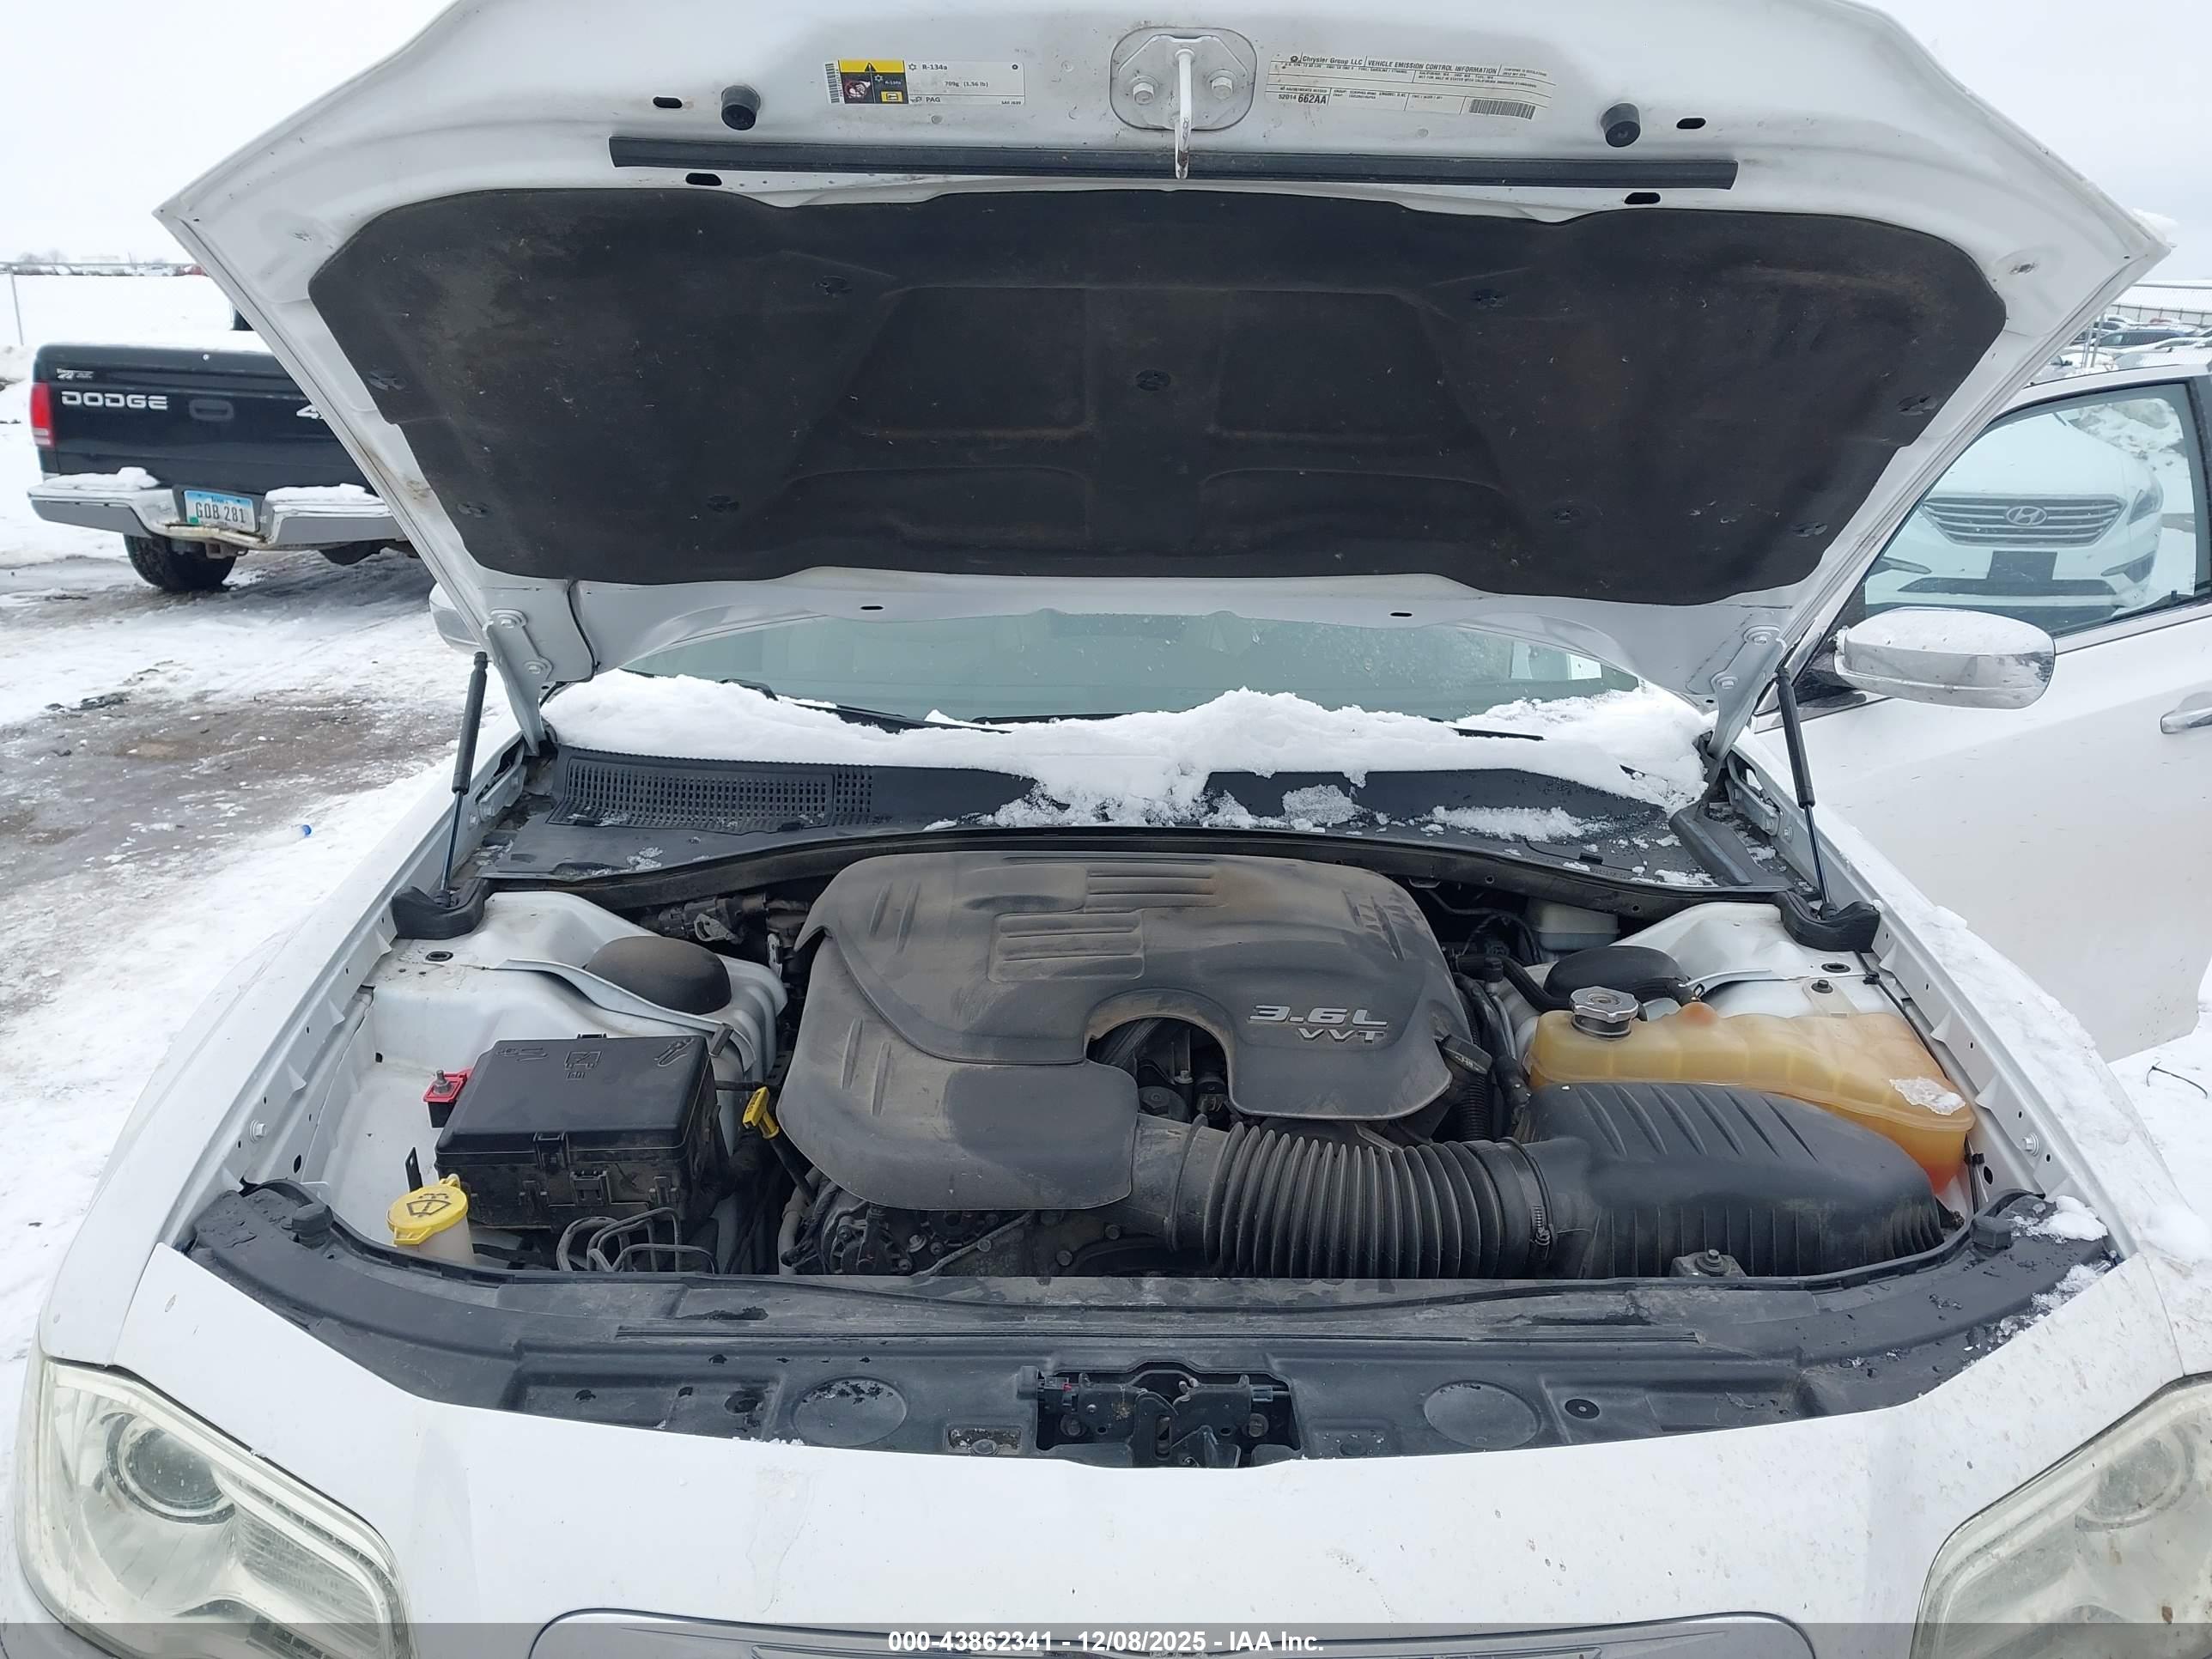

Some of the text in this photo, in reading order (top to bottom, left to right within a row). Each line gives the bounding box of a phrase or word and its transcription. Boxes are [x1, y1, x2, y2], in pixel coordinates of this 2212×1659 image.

[1329, 57, 1349, 65] Group
[1455, 65, 1498, 74] INFORMATION
[1298, 94, 1327, 104] 662AA
[61, 390, 168, 411] DODGE
[224, 505, 246, 524] 281
[1249, 1005, 1388, 1027] 3.6L
[1298, 1028, 1385, 1042] VVT
